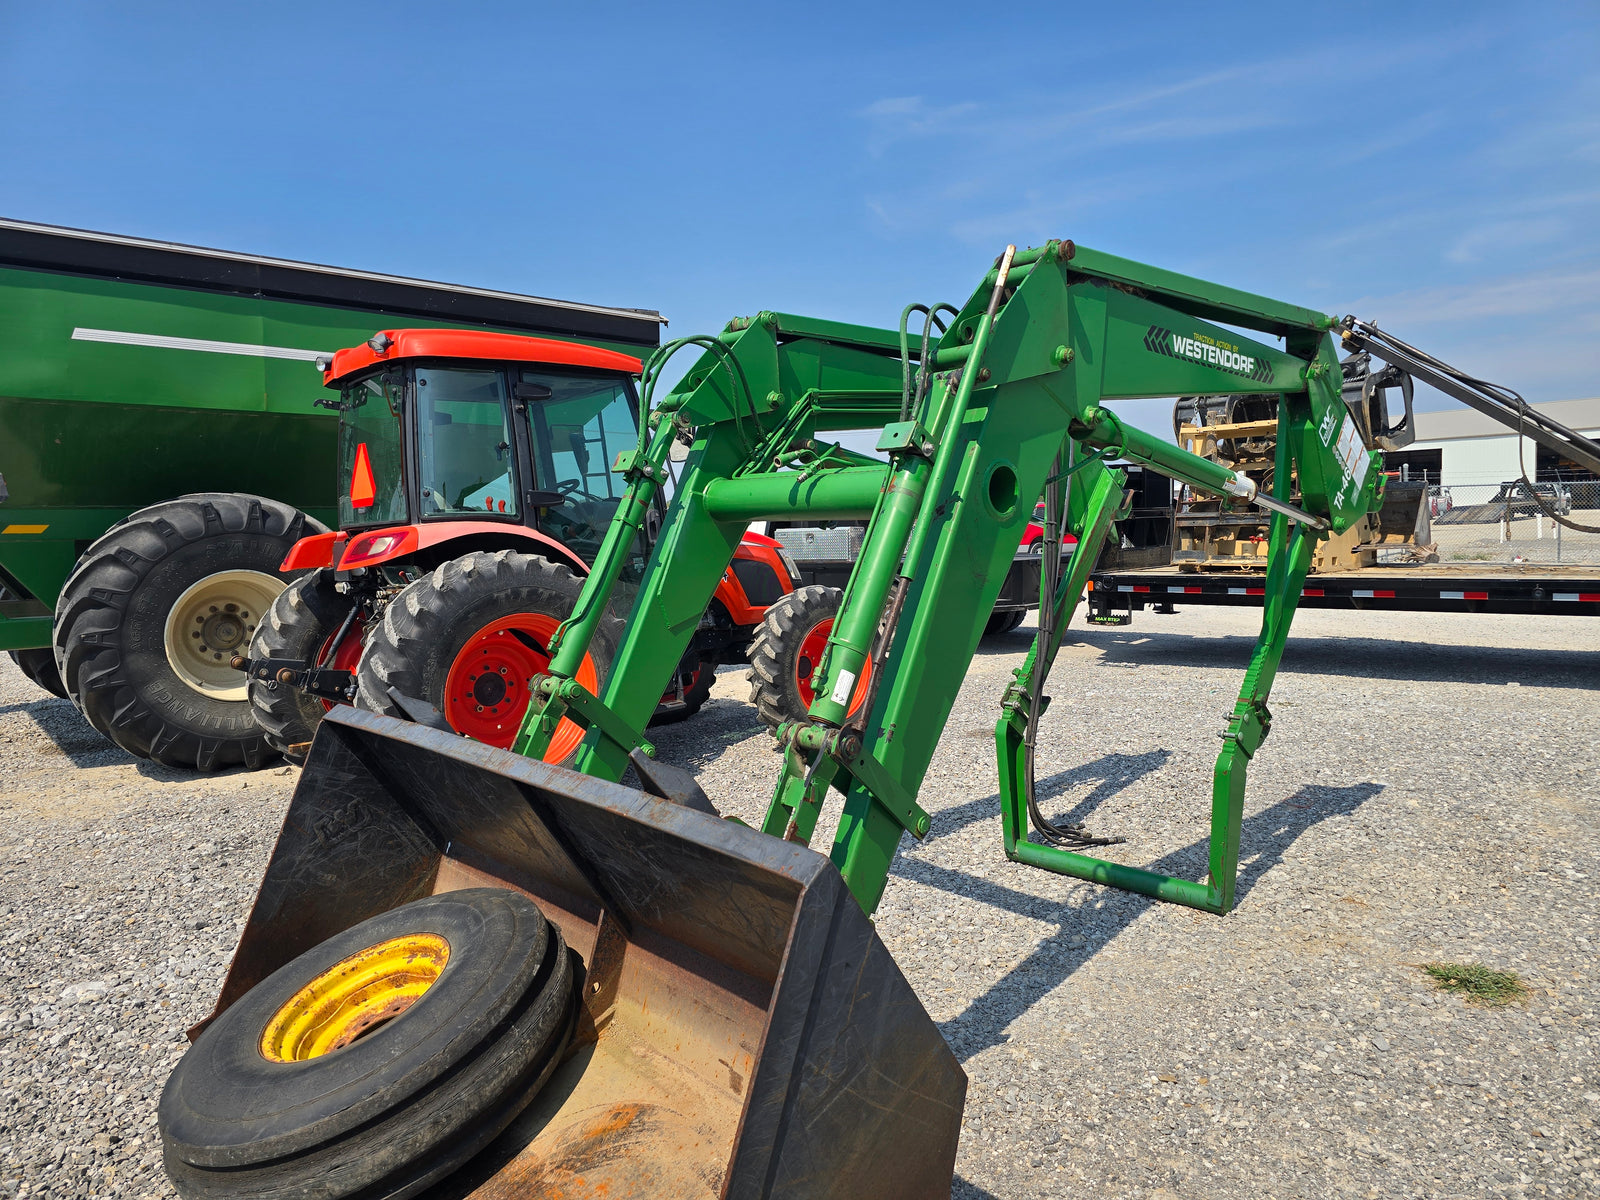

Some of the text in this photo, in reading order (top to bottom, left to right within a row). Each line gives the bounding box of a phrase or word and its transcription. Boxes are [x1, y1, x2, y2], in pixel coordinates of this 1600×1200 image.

[1173, 334, 1255, 373] WESTENDORF
[1333, 466, 1352, 510] TA-46
[144, 680, 259, 730] ALLIANCE
